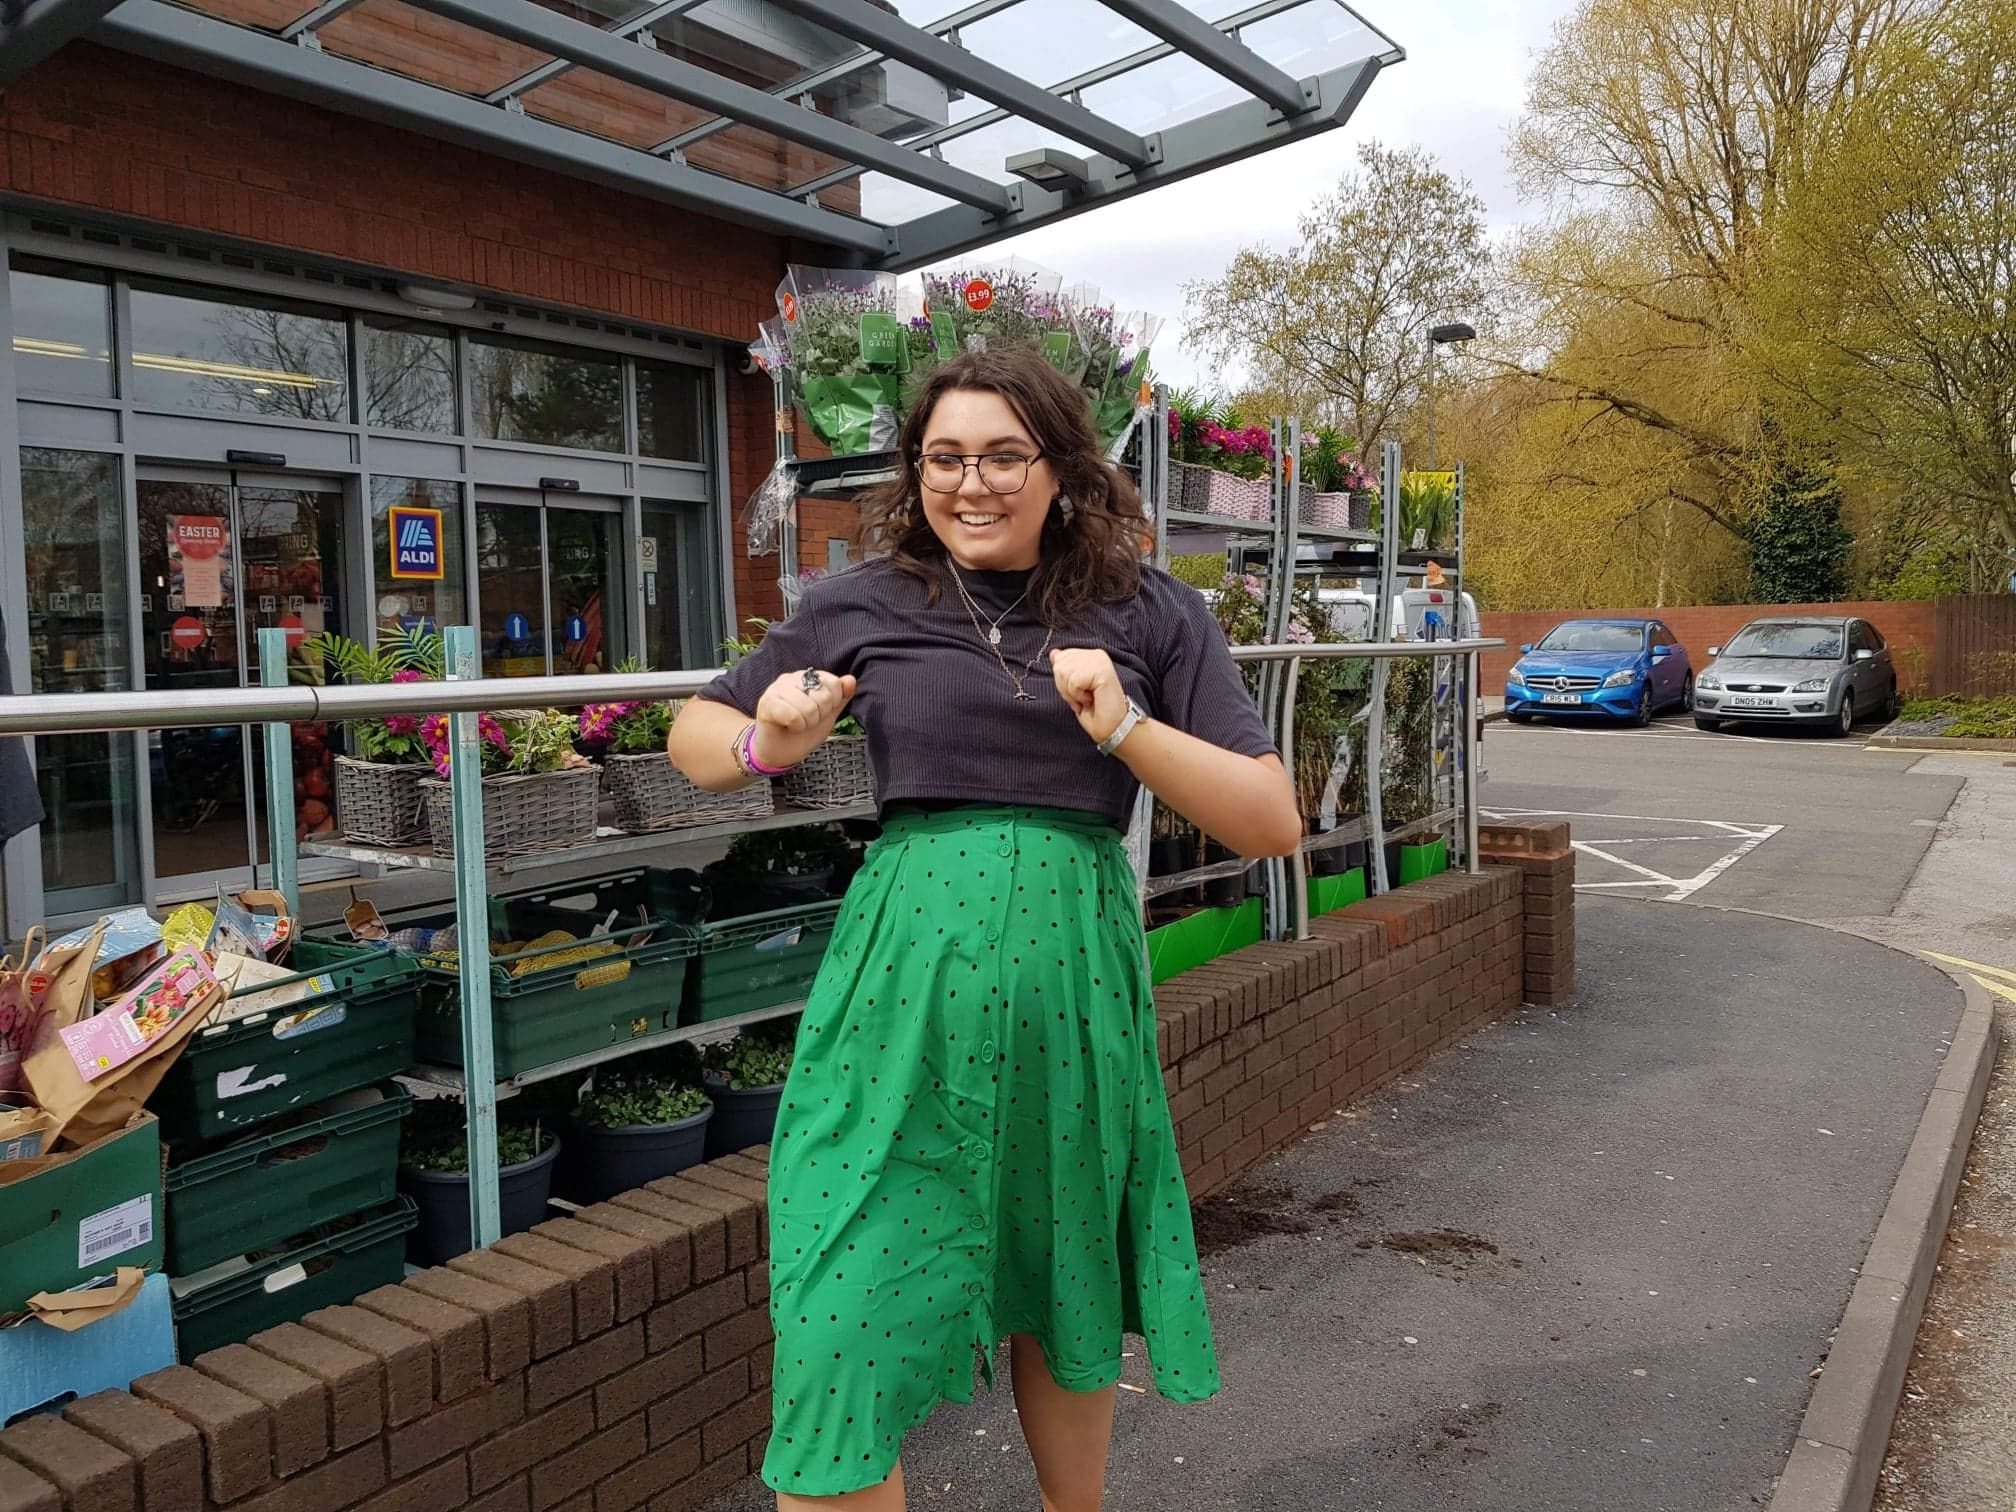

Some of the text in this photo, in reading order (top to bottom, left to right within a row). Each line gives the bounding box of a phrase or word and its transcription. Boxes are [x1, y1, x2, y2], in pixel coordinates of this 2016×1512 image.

[968, 289, 990, 302] £3.99
[179, 526, 220, 538] EASTER
[400, 551, 435, 564] ALDI
[1735, 697, 1774, 706] DN05 ZHW
